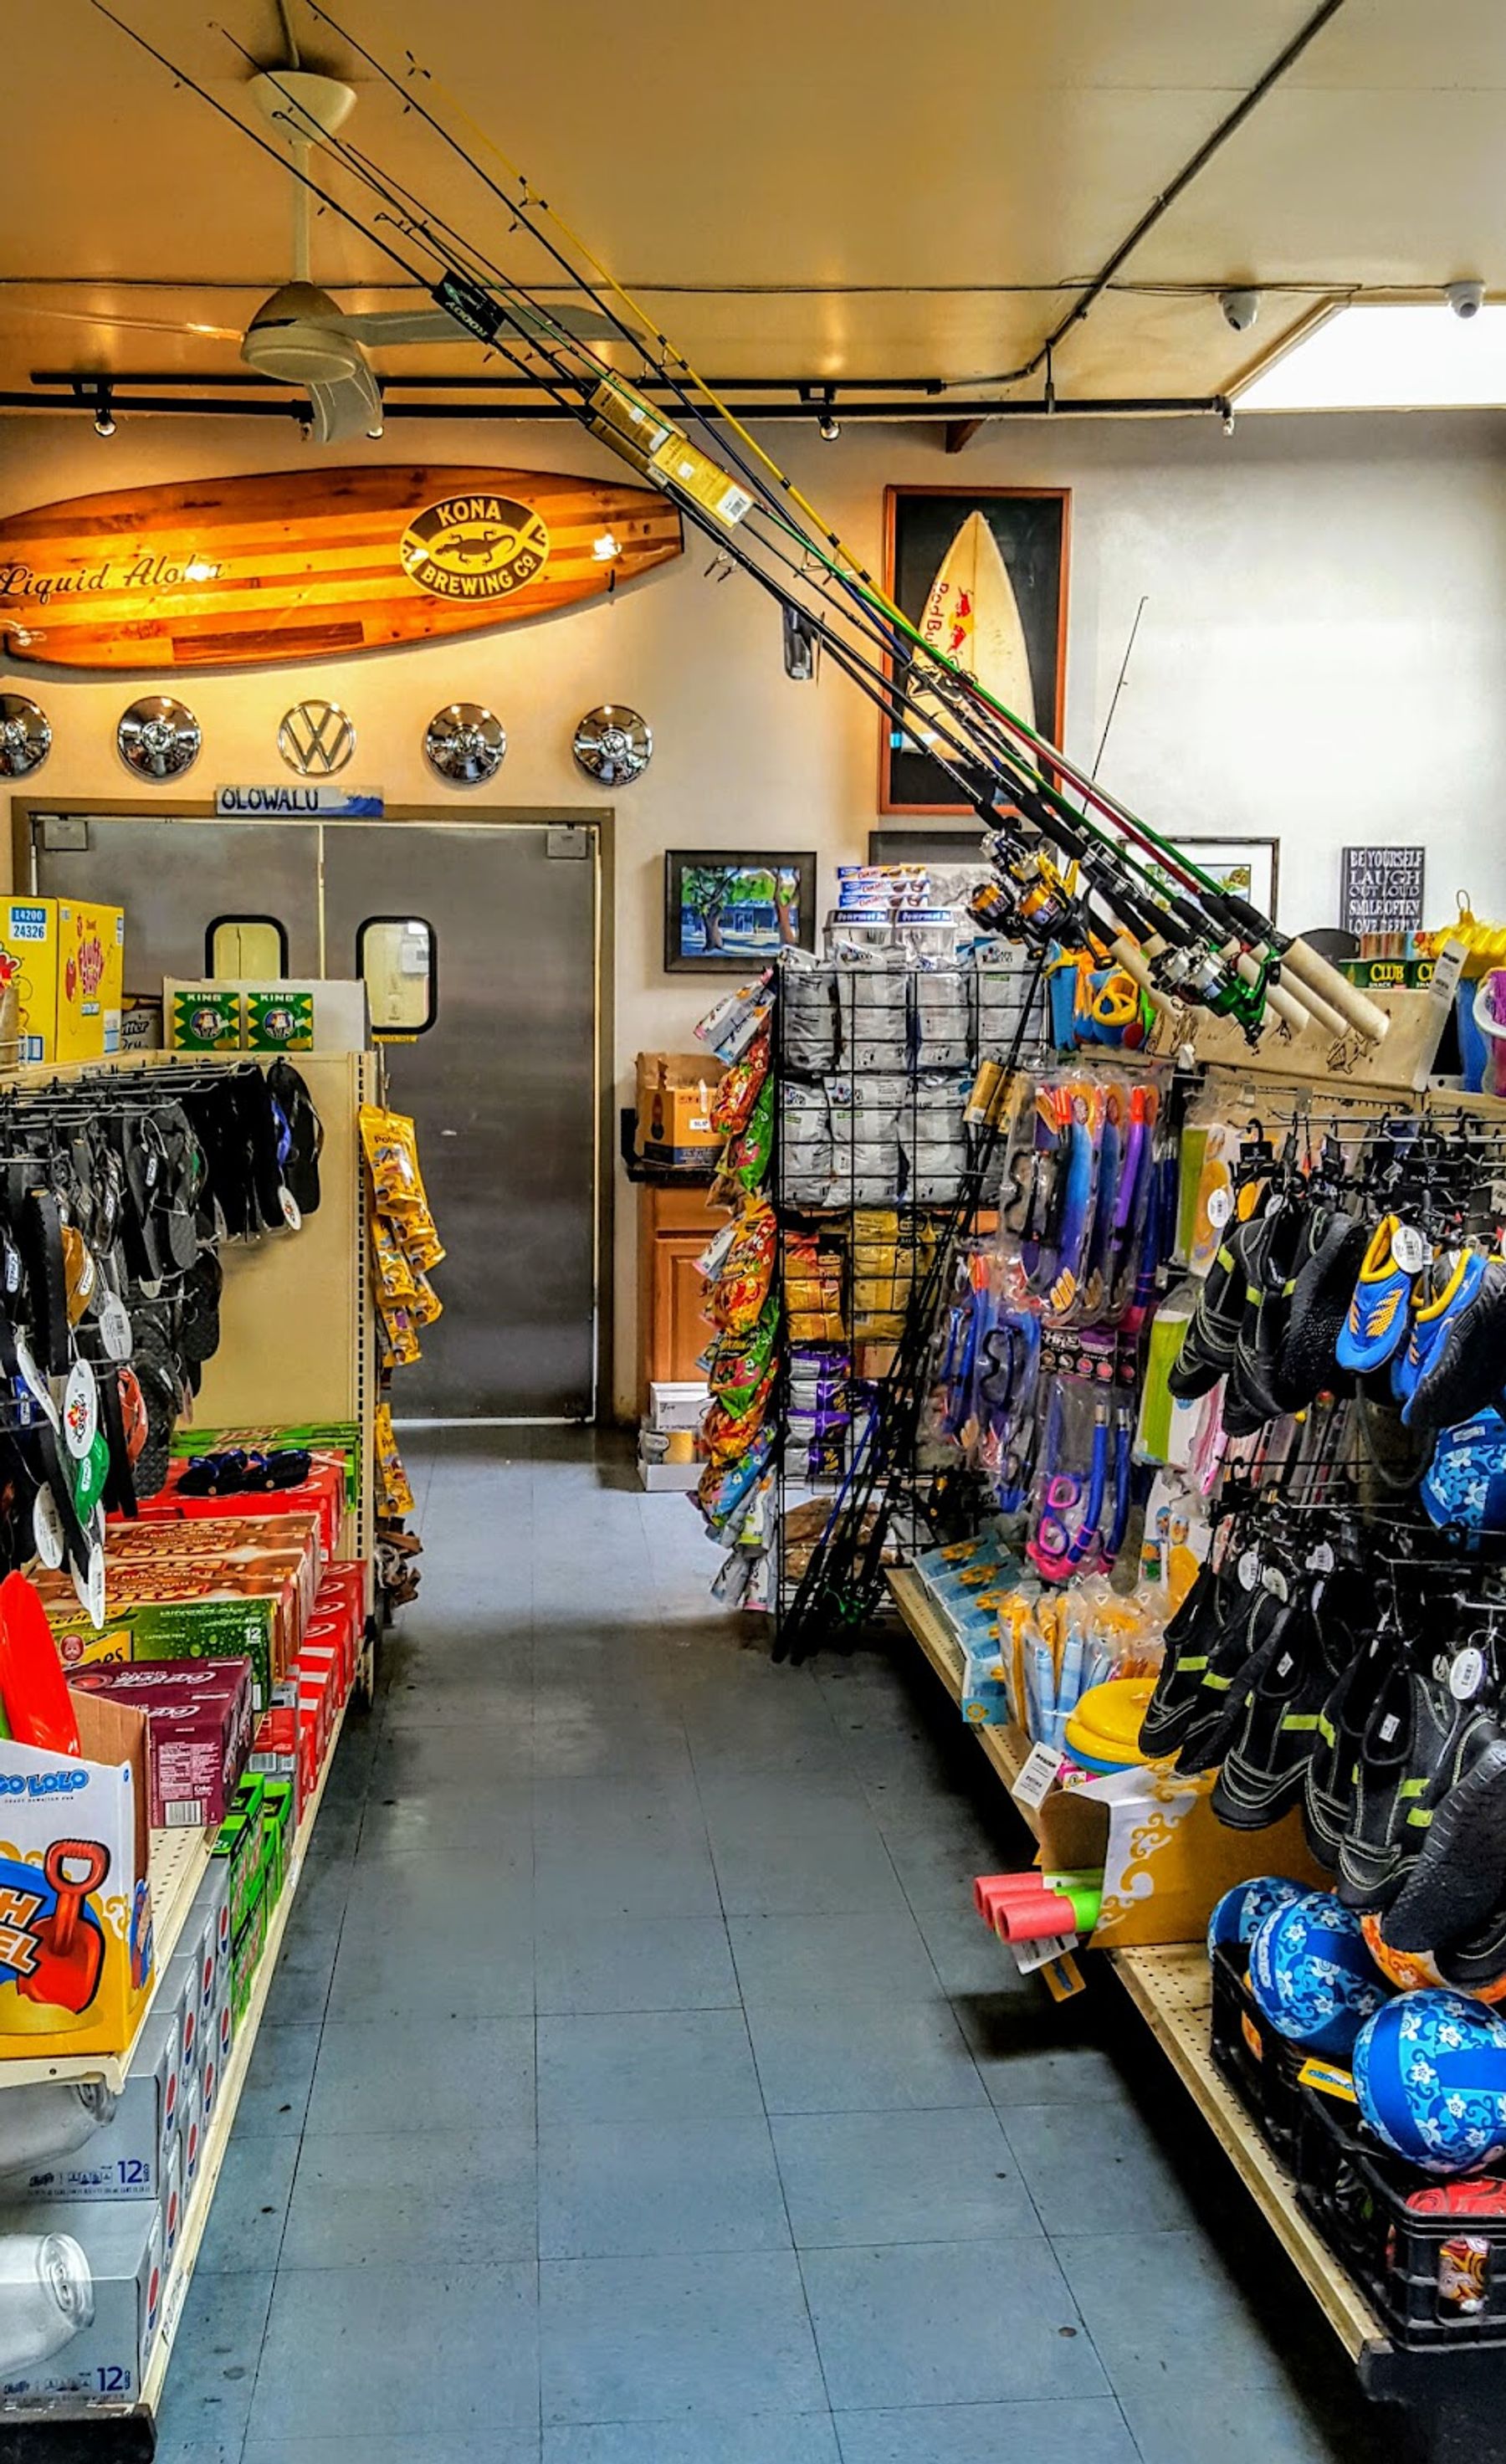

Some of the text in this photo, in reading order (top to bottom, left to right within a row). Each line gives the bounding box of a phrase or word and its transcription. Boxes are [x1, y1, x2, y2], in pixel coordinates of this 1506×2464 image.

[436, 498, 502, 527] KONA
[0, 563, 110, 605] Liquid
[420, 565, 514, 596] BREWING
[924, 619, 942, 649] Bul
[221, 788, 319, 812] OLOWALU
[1350, 850, 1422, 868] BE YOURSELF
[1350, 870, 1421, 885] LAUGH
[1349, 885, 1420, 897] OUT LOUD
[14, 909, 43, 921] 14200
[1349, 899, 1420, 916] SMILE OFTEN
[13, 925, 44, 939] 24326
[1370, 963, 1405, 981] CLUB
[187, 993, 223, 1002] KING
[259, 993, 295, 1002] KING
[245, 1627, 261, 1638] 12
[27, 1768, 90, 1797] LOLO
[117, 2159, 143, 2185] 12
[96, 2365, 124, 2392] 12
